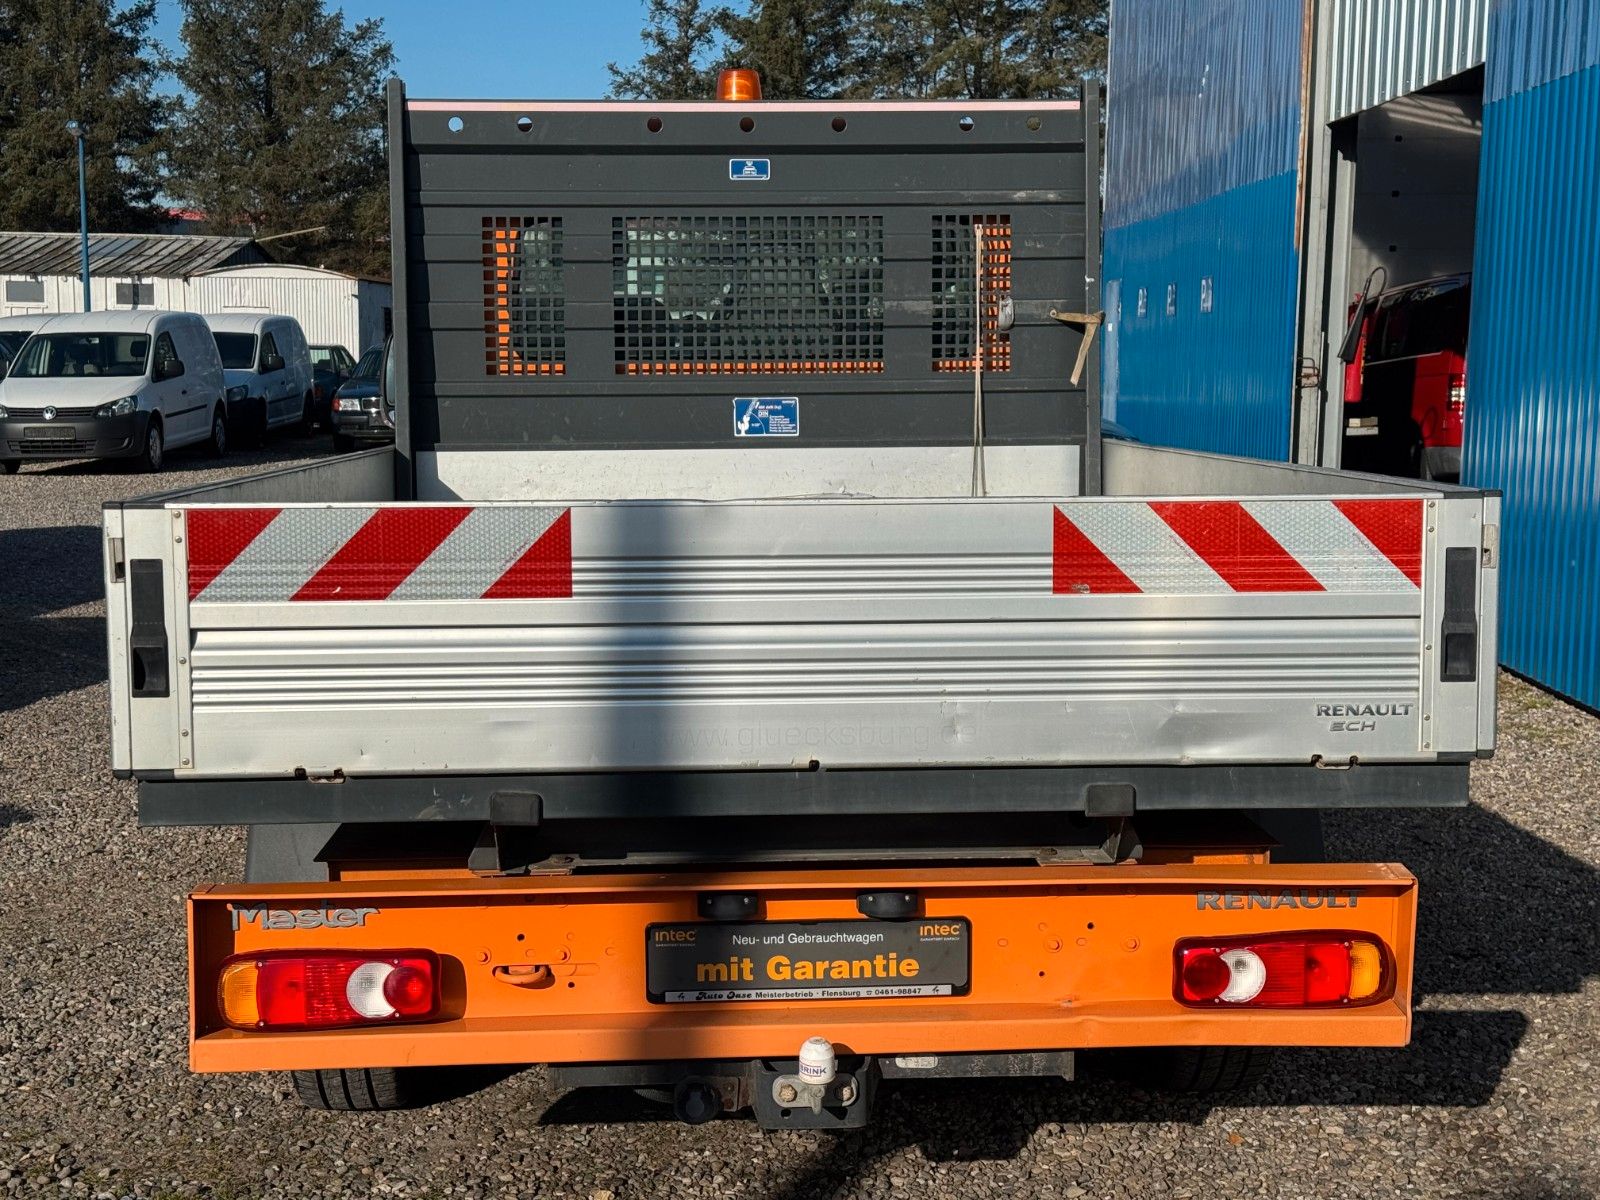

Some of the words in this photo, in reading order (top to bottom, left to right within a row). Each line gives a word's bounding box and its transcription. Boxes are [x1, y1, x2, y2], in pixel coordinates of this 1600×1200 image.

[1317, 703, 1413, 716] RENAULT
[1196, 888, 1365, 910] RENAULT
[226, 900, 380, 931] Master
[655, 929, 696, 941] intec
[920, 923, 961, 936] intec
[732, 934, 760, 945] Neu-
[763, 934, 784, 944] und
[788, 932, 884, 944] Gebrauchtwagen
[697, 956, 753, 982] mit
[766, 952, 920, 981] Garantie
[696, 991, 723, 1000] Auto
[755, 991, 813, 999] Meisterbetrieb
